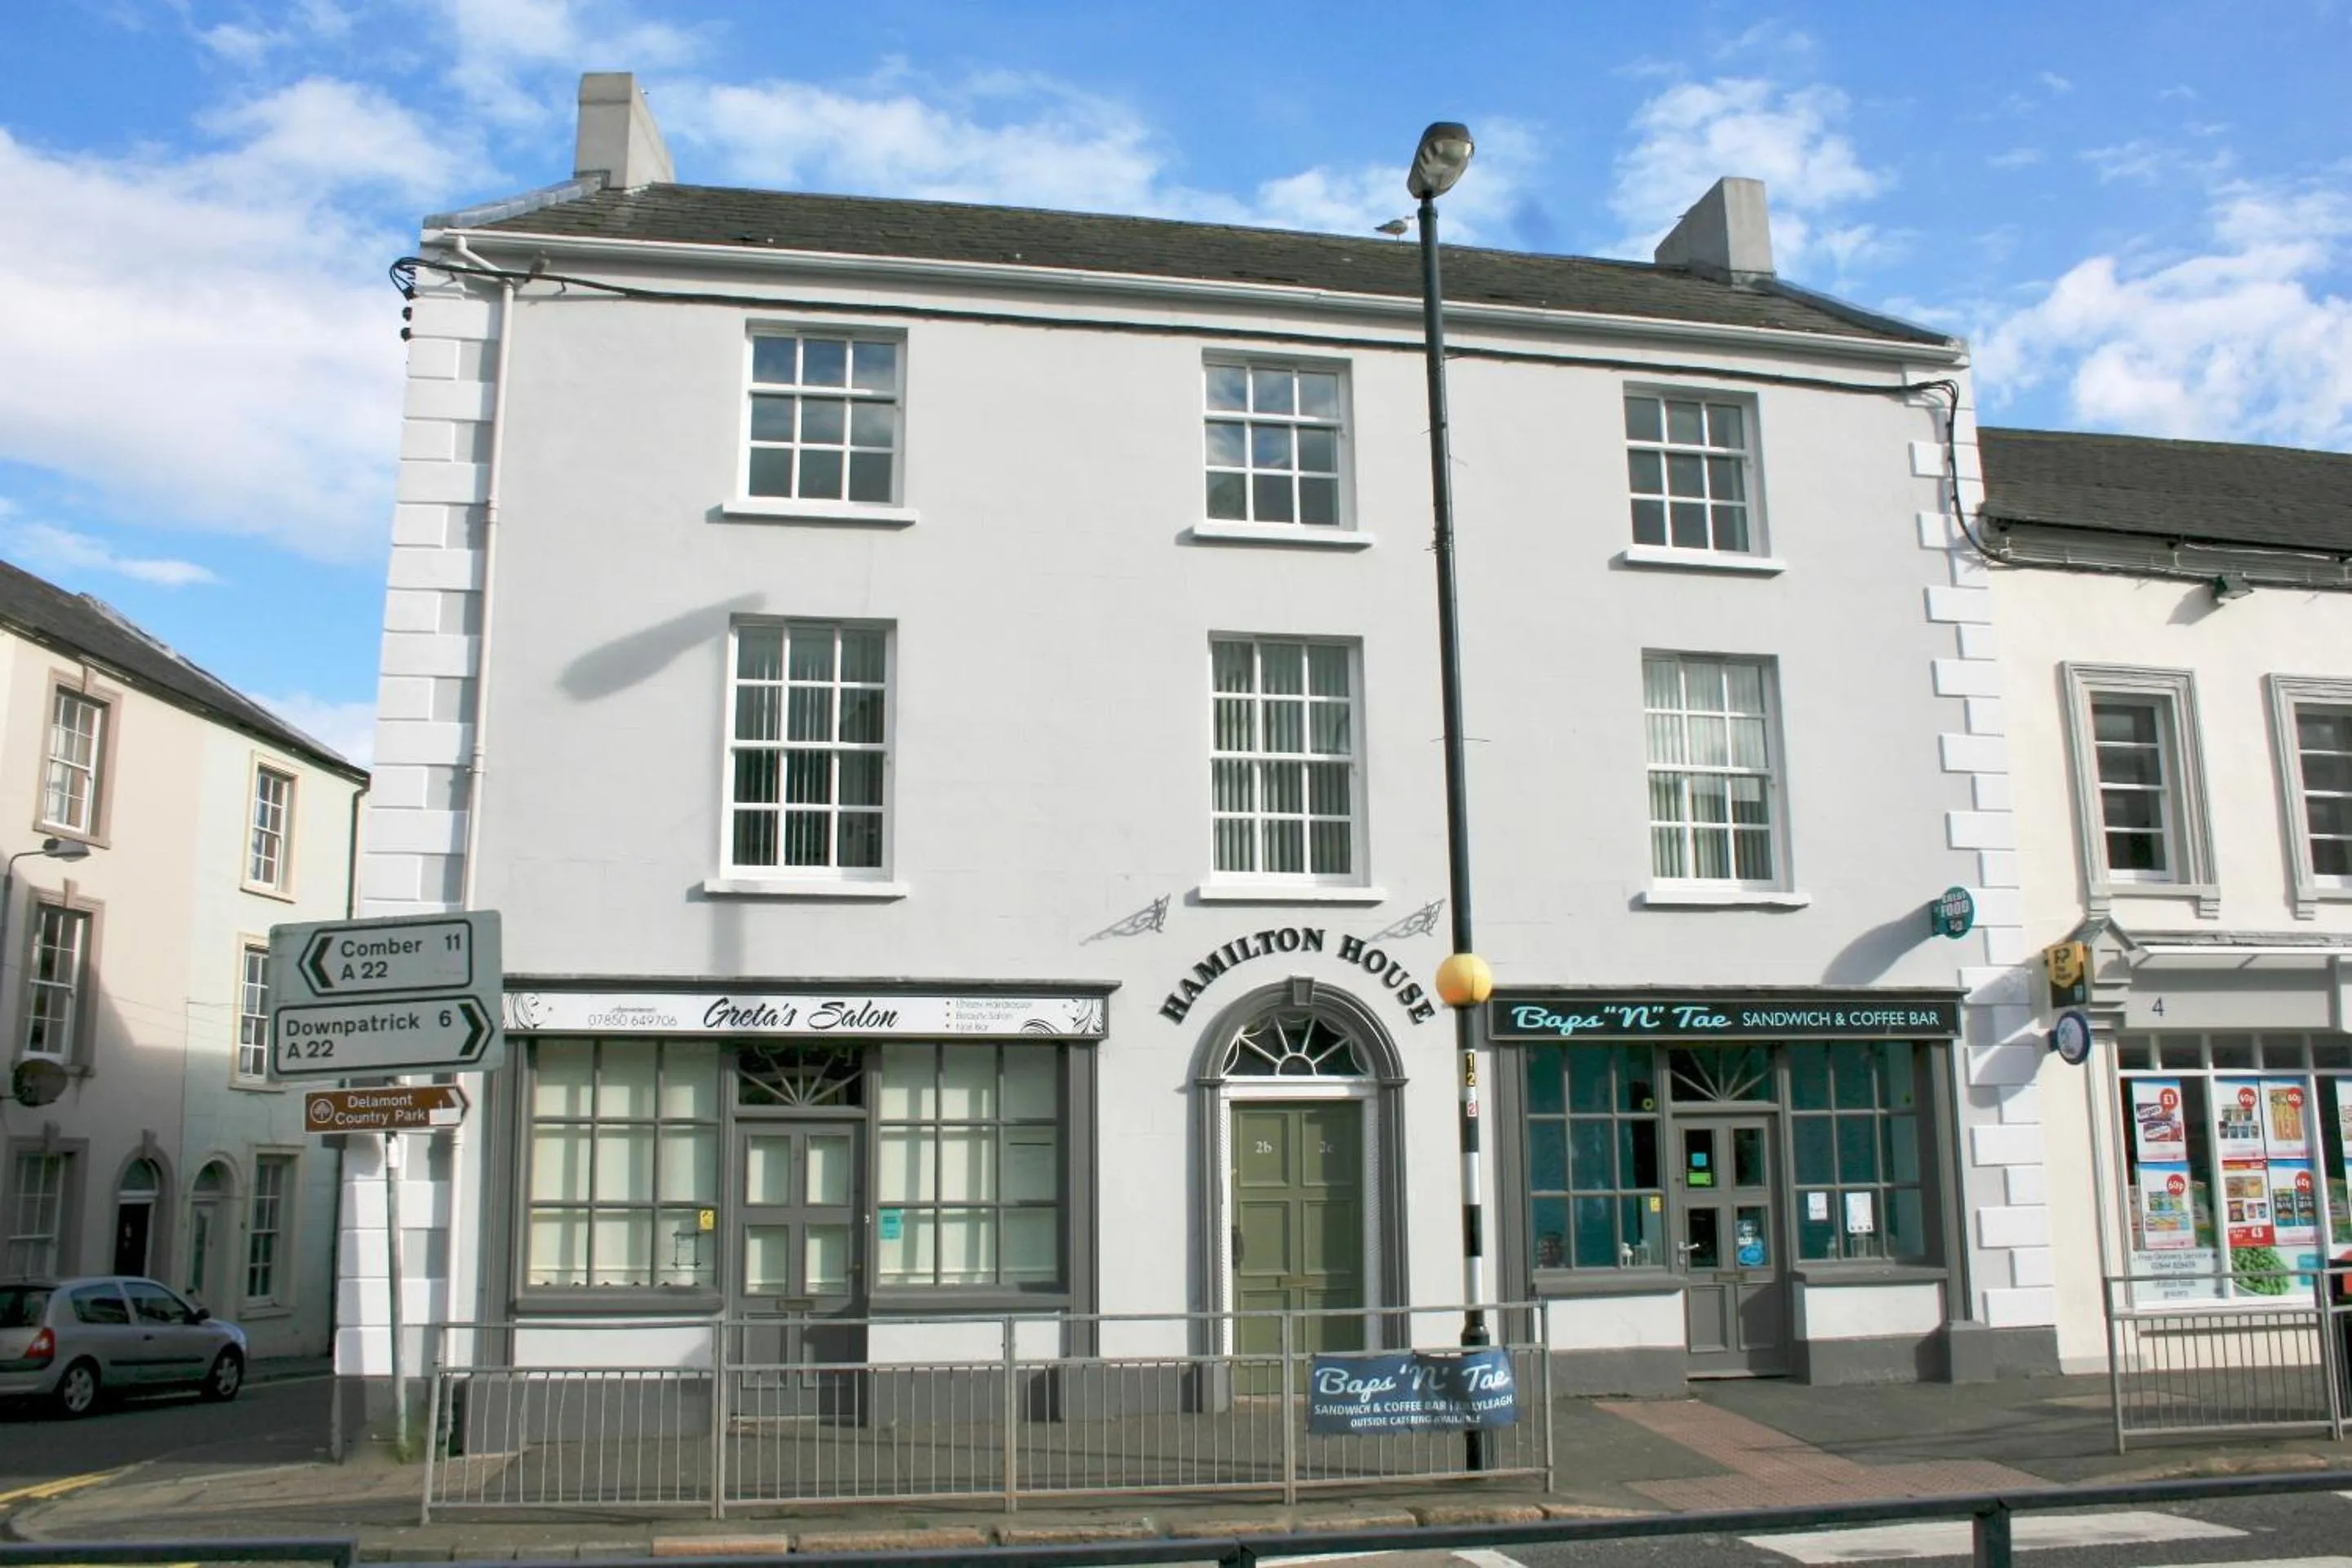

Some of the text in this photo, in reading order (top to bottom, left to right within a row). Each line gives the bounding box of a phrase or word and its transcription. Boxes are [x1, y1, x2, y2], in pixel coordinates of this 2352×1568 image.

[340, 934, 462, 959] Comber 11
[1158, 926, 1435, 1025] HAMILTON HOUSE
[703, 997, 899, 1030] Greta's Salon
[2151, 997, 2165, 1017] 4
[286, 1010, 452, 1038] Downpatrick 6
[1511, 1006, 1604, 1036] Baps
[1671, 1006, 1732, 1028] Tae
[1741, 1011, 1940, 1027] SANDWICH & COFFEE BAR
[347, 1095, 414, 1109] Delamont
[335, 1108, 427, 1126] Country Park
[1255, 1140, 1273, 1154] 2b
[1315, 1367, 1396, 1402] Baps
[1461, 1364, 1510, 1393] Tae
[1314, 1403, 1371, 1416] SANDWICH
[1373, 1402, 1381, 1413] &
[1384, 1400, 1422, 1413] COFFEE
[1350, 1416, 1388, 1428] OUTSIDE
